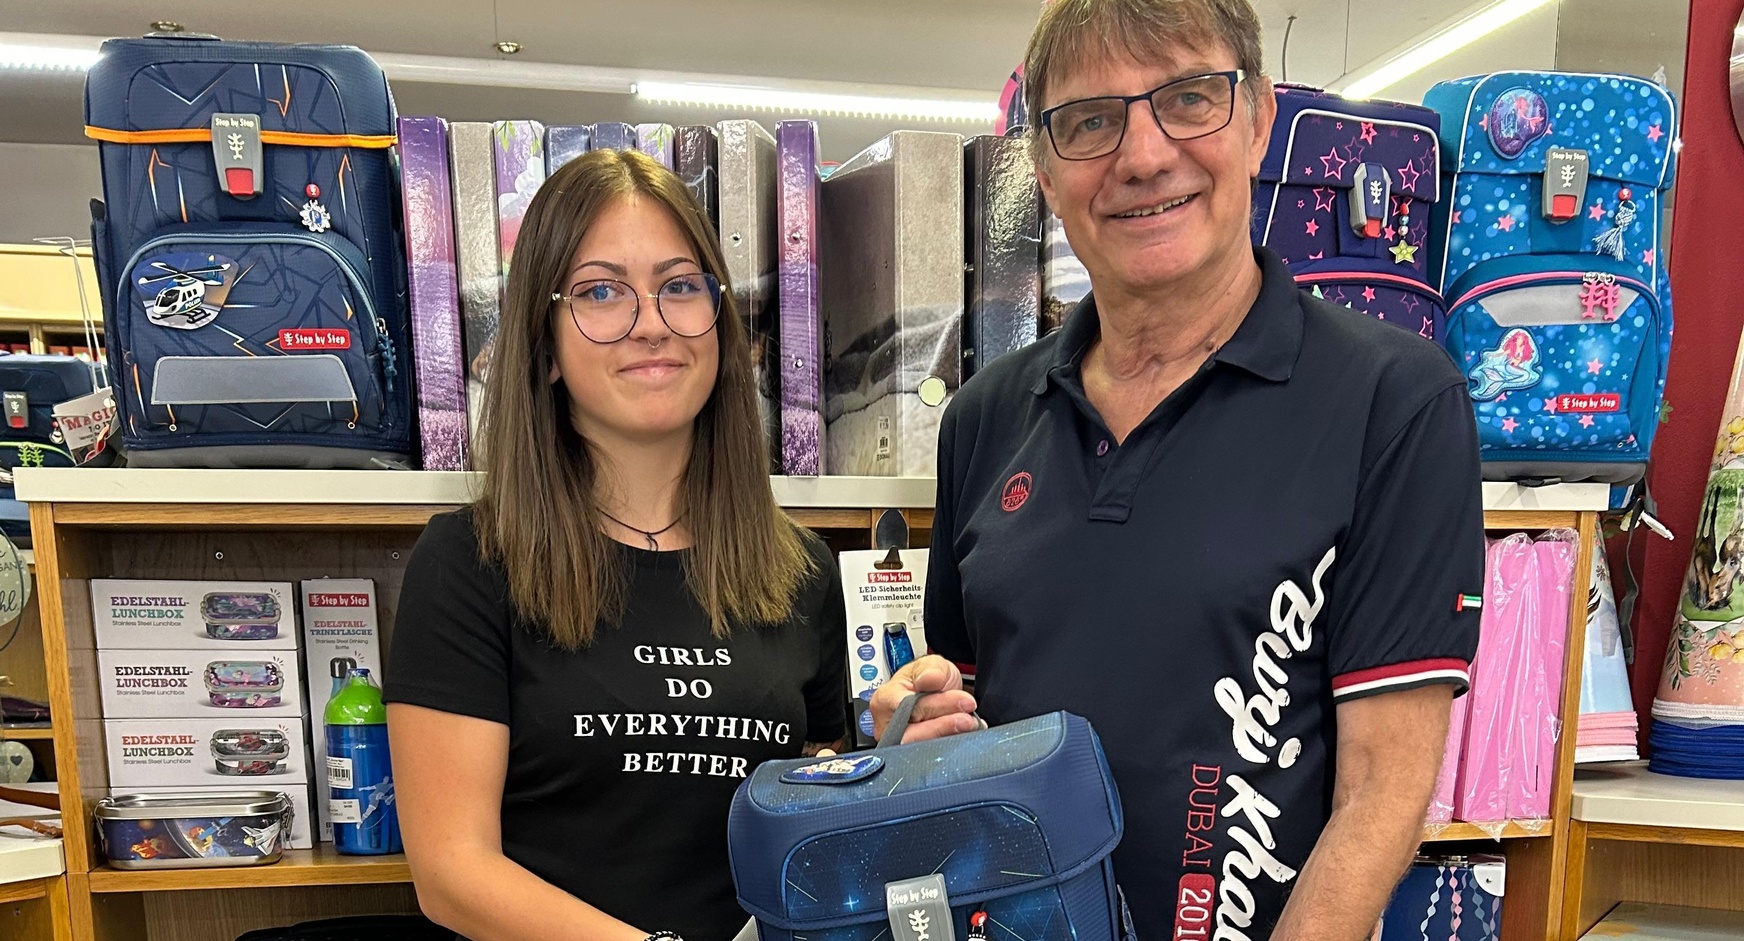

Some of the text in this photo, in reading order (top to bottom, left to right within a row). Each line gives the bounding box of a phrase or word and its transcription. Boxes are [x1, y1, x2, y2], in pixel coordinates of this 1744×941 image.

[215, 117, 255, 128] Step by Step
[1552, 151, 1586, 161] Step by Step
[295, 332, 346, 346] Step by Step
[1571, 396, 1616, 409] Step by Step
[876, 571, 911, 582] Step by Step
[859, 585, 877, 594] LED
[110, 596, 190, 607] EDELSTAHL-
[320, 594, 367, 607] Step by Step
[862, 593, 922, 602] Klemmleuchte
[111, 608, 185, 619] LUNCHBOX
[314, 620, 368, 628] EDELSTAHL-
[633, 645, 732, 666] GIRLS
[115, 666, 194, 676] EDELSTAHL-
[116, 678, 188, 688] LUNCHBOX
[665, 678, 713, 699] DO
[573, 713, 791, 745] EVERYTHING
[122, 735, 200, 745] EDELSTAHL-
[1212, 545, 1336, 941] Burj Kha
[123, 746, 194, 757] LUNCHBOX
[621, 752, 748, 778] BETTER
[1176, 763, 1222, 941] DUBAI 201
[891, 886, 939, 905] Step by Step
